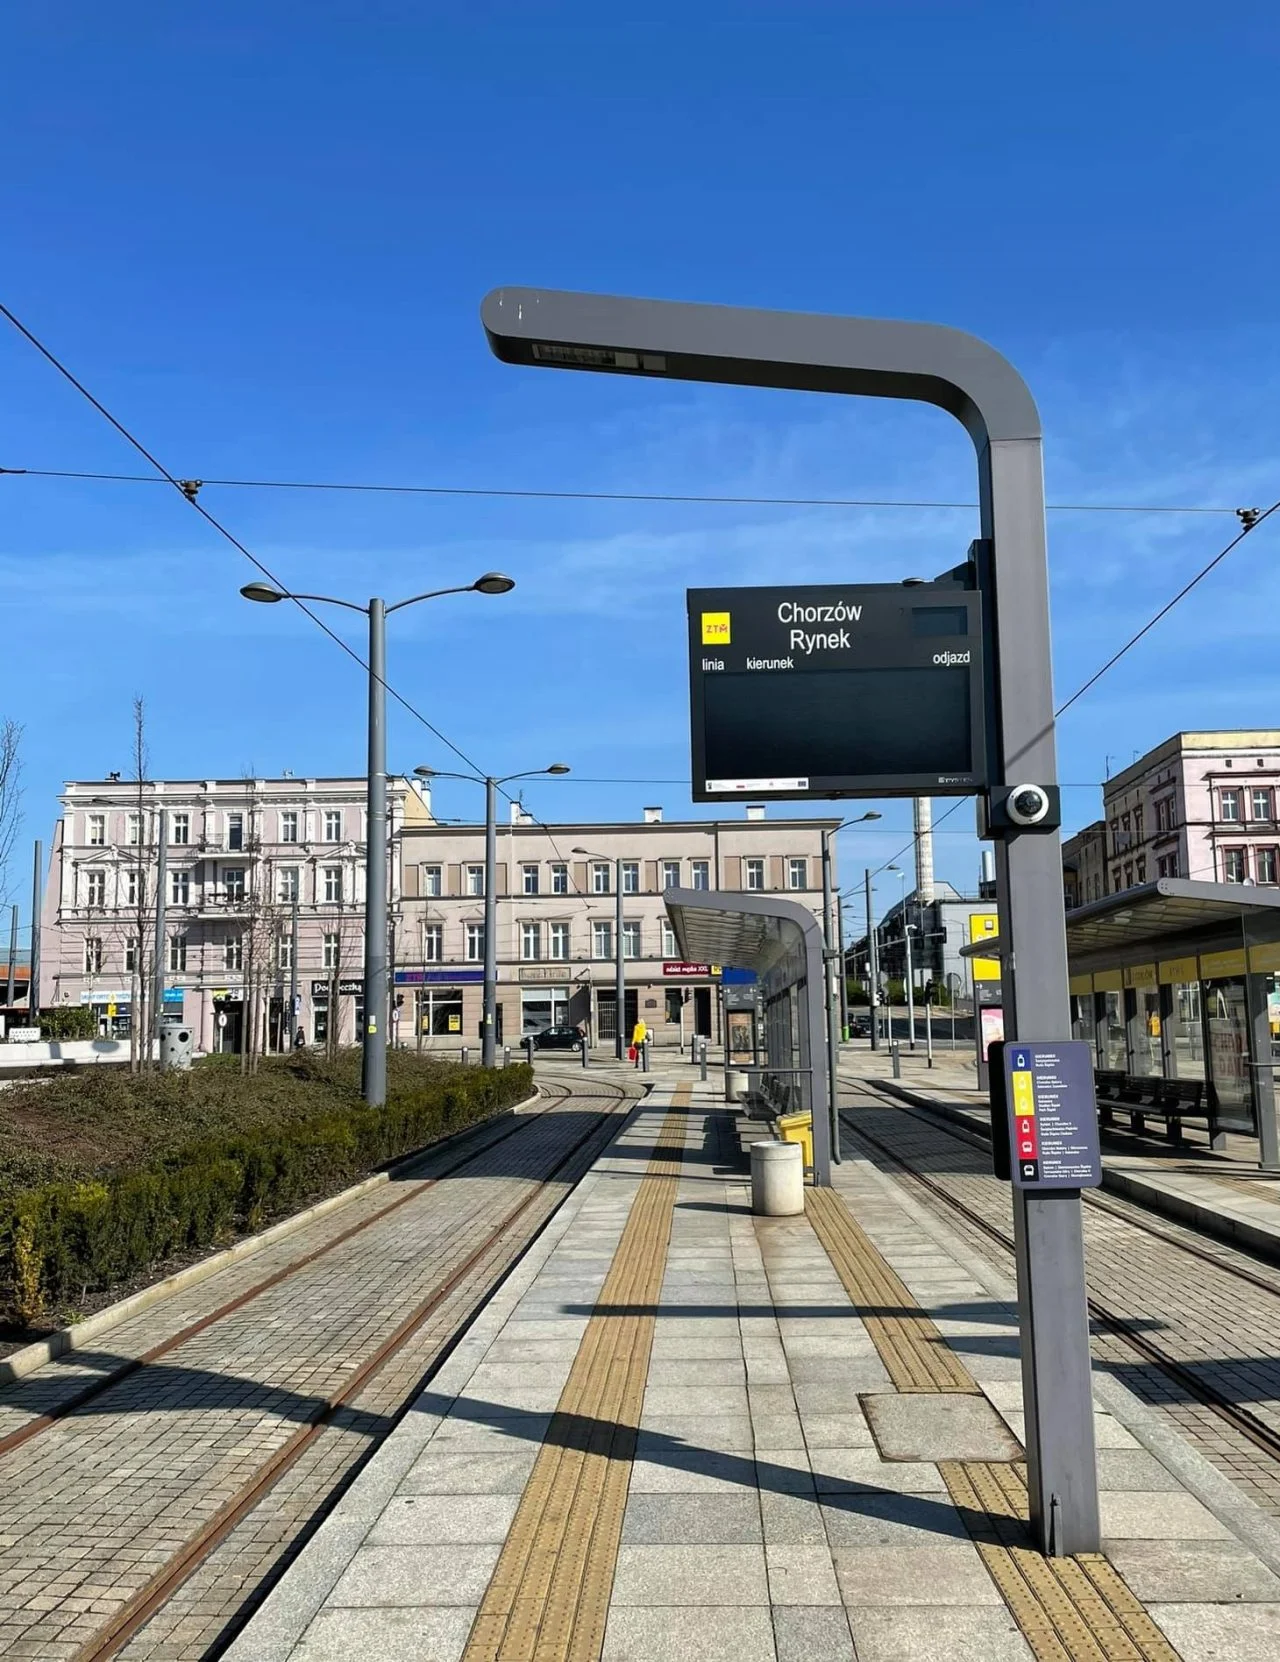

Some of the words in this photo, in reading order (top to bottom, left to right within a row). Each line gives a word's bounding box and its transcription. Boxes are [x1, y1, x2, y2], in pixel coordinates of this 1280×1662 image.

[777, 601, 862, 624] Chorzów
[790, 629, 851, 654] Rynek
[702, 657, 725, 671] linia
[746, 656, 794, 670] kierunek
[933, 650, 970, 666] odjazd
